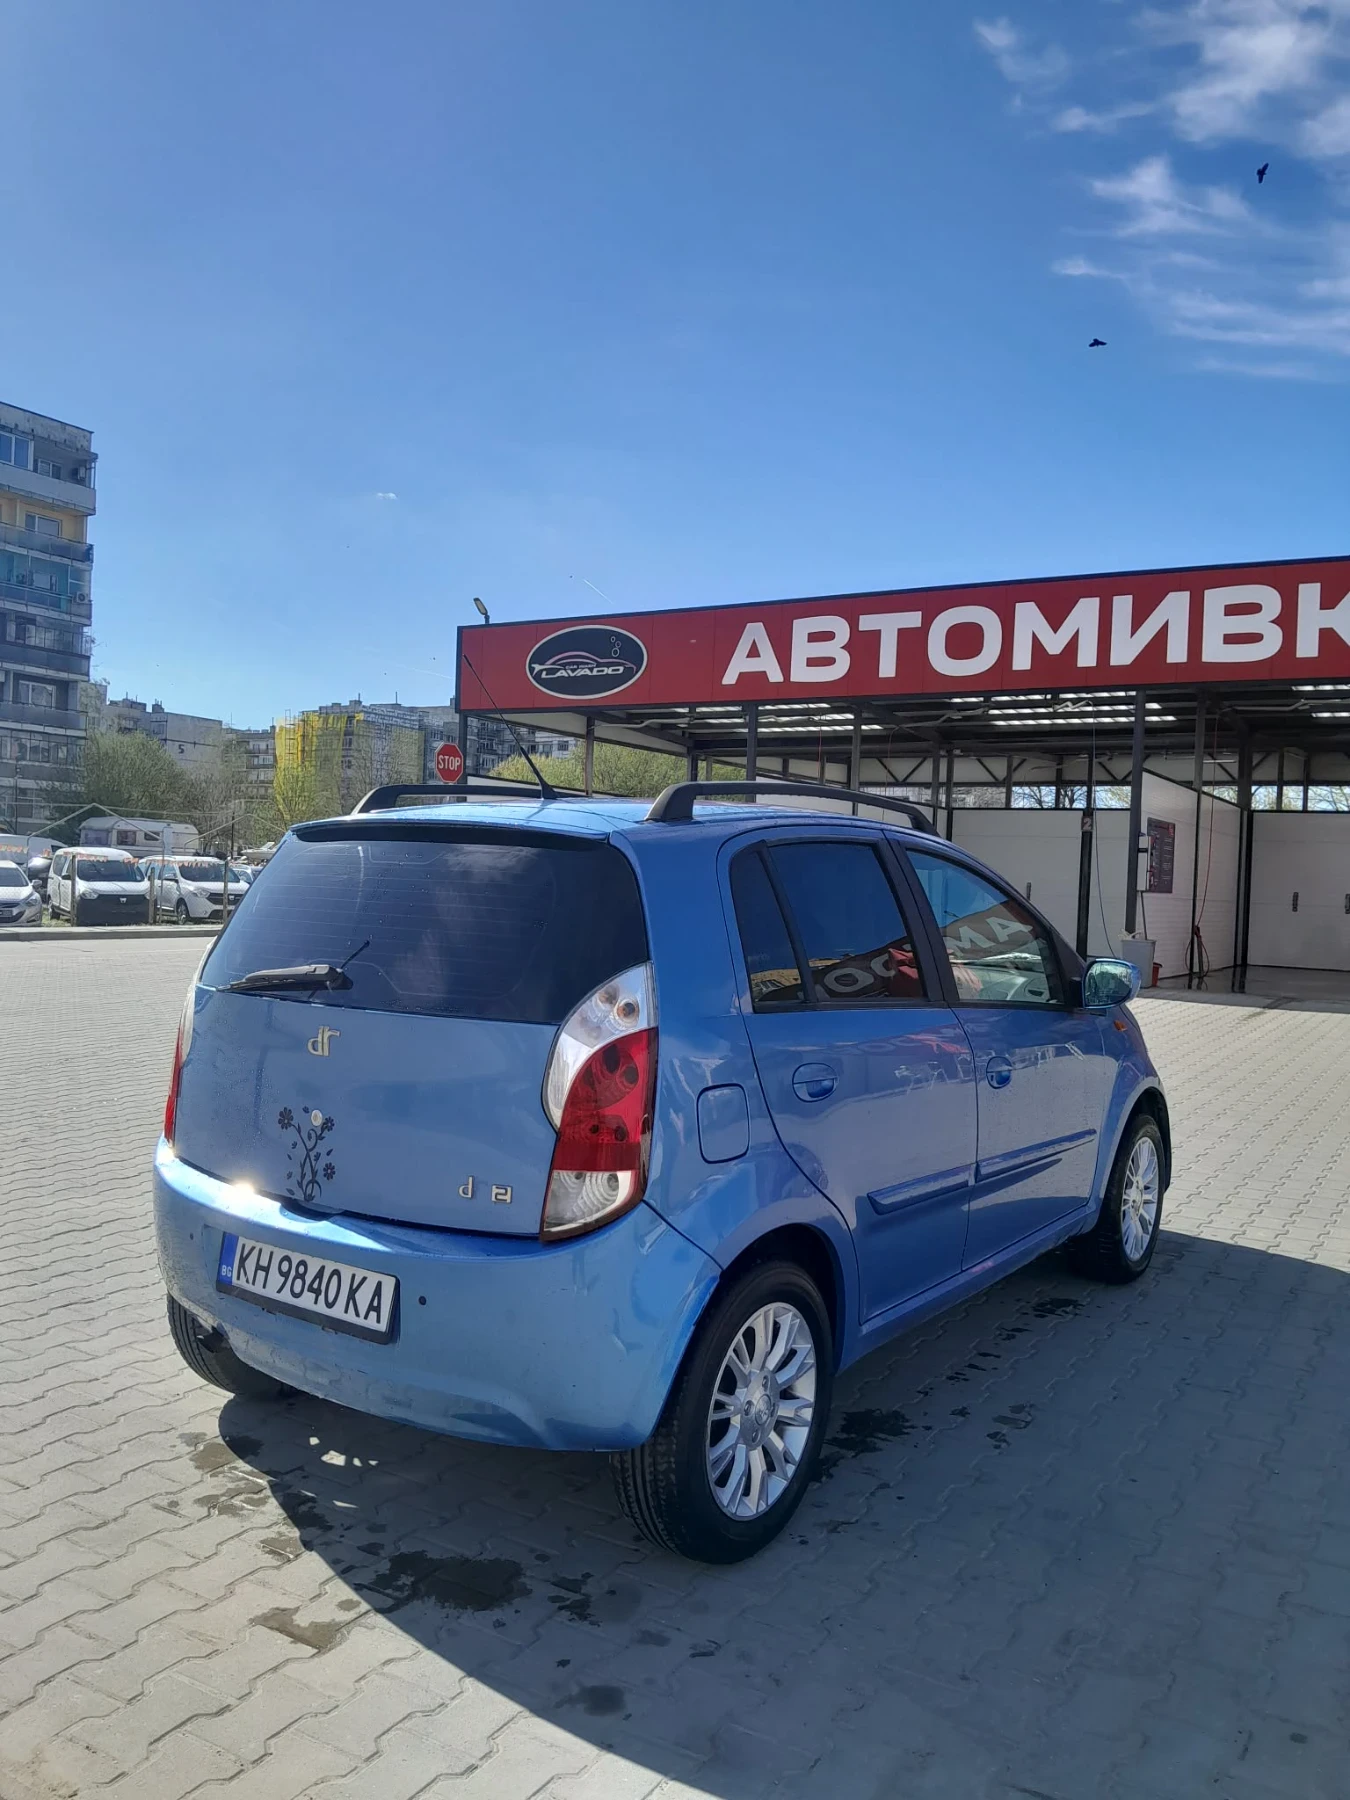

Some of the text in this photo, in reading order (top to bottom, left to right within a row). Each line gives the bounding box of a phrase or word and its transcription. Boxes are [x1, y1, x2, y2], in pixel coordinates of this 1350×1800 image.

[722, 582, 1350, 685] АВТОМИВК
[541, 665, 625, 679] LAVADO
[178, 743, 185, 754] 5
[438, 755, 461, 771] STOP
[307, 1025, 341, 1057] dr
[221, 1264, 232, 1278] BG
